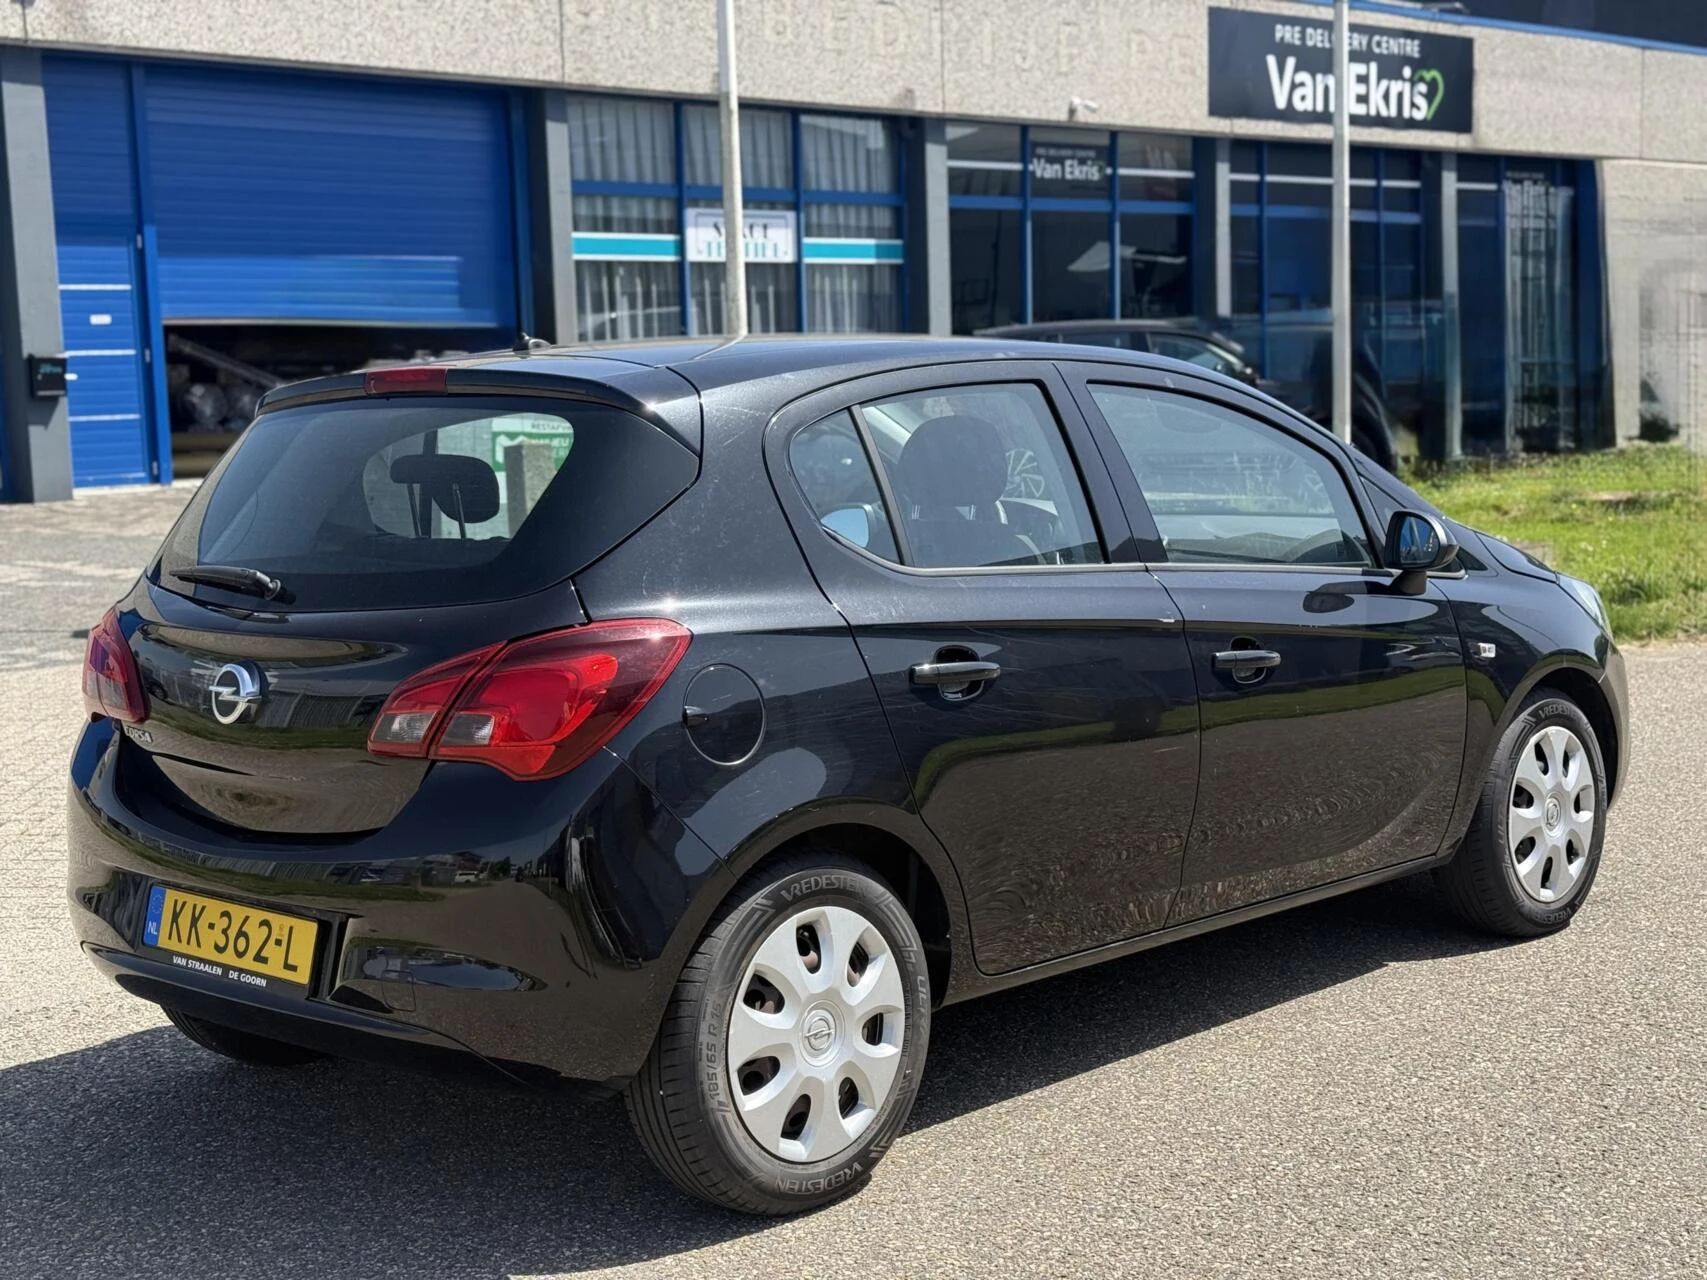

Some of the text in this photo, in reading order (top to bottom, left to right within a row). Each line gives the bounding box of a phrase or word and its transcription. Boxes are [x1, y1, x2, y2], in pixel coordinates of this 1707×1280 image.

[1274, 24, 1421, 58] PRE DELERY CENTRE
[1266, 54, 1429, 121] Van Ekris
[1032, 157, 1099, 181] Van Ekris
[147, 921, 158, 936] NL
[167, 898, 299, 973] KK-362-L
[172, 955, 267, 987] VAN STRAALEN DE GOORN
